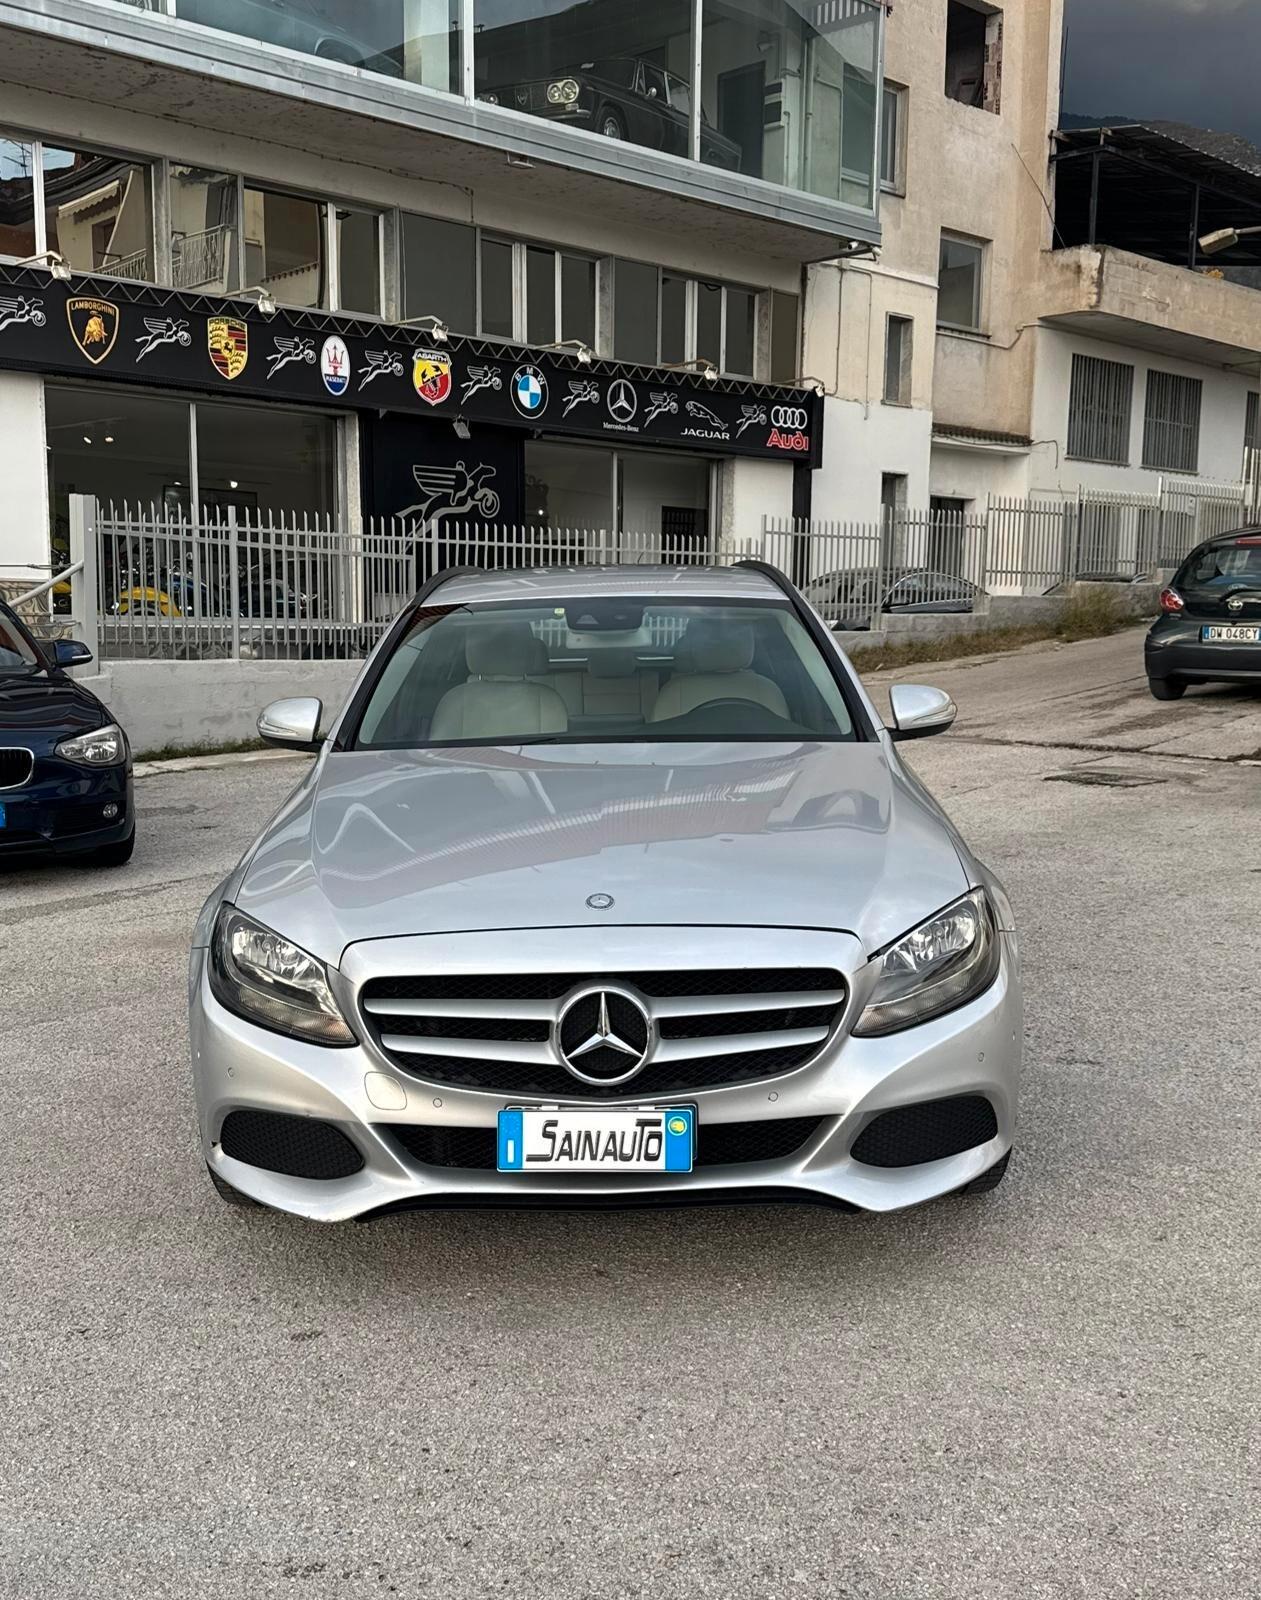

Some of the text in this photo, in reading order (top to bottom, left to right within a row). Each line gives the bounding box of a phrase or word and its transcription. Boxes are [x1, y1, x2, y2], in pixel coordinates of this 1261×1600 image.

[71, 301, 115, 316] LAMBORGHINI
[416, 352, 448, 363] ABARTH
[515, 366, 545, 385] BMW
[680, 427, 730, 440] JAGUAR
[766, 428, 809, 451] Audi
[1211, 628, 1258, 639] DW 048CY
